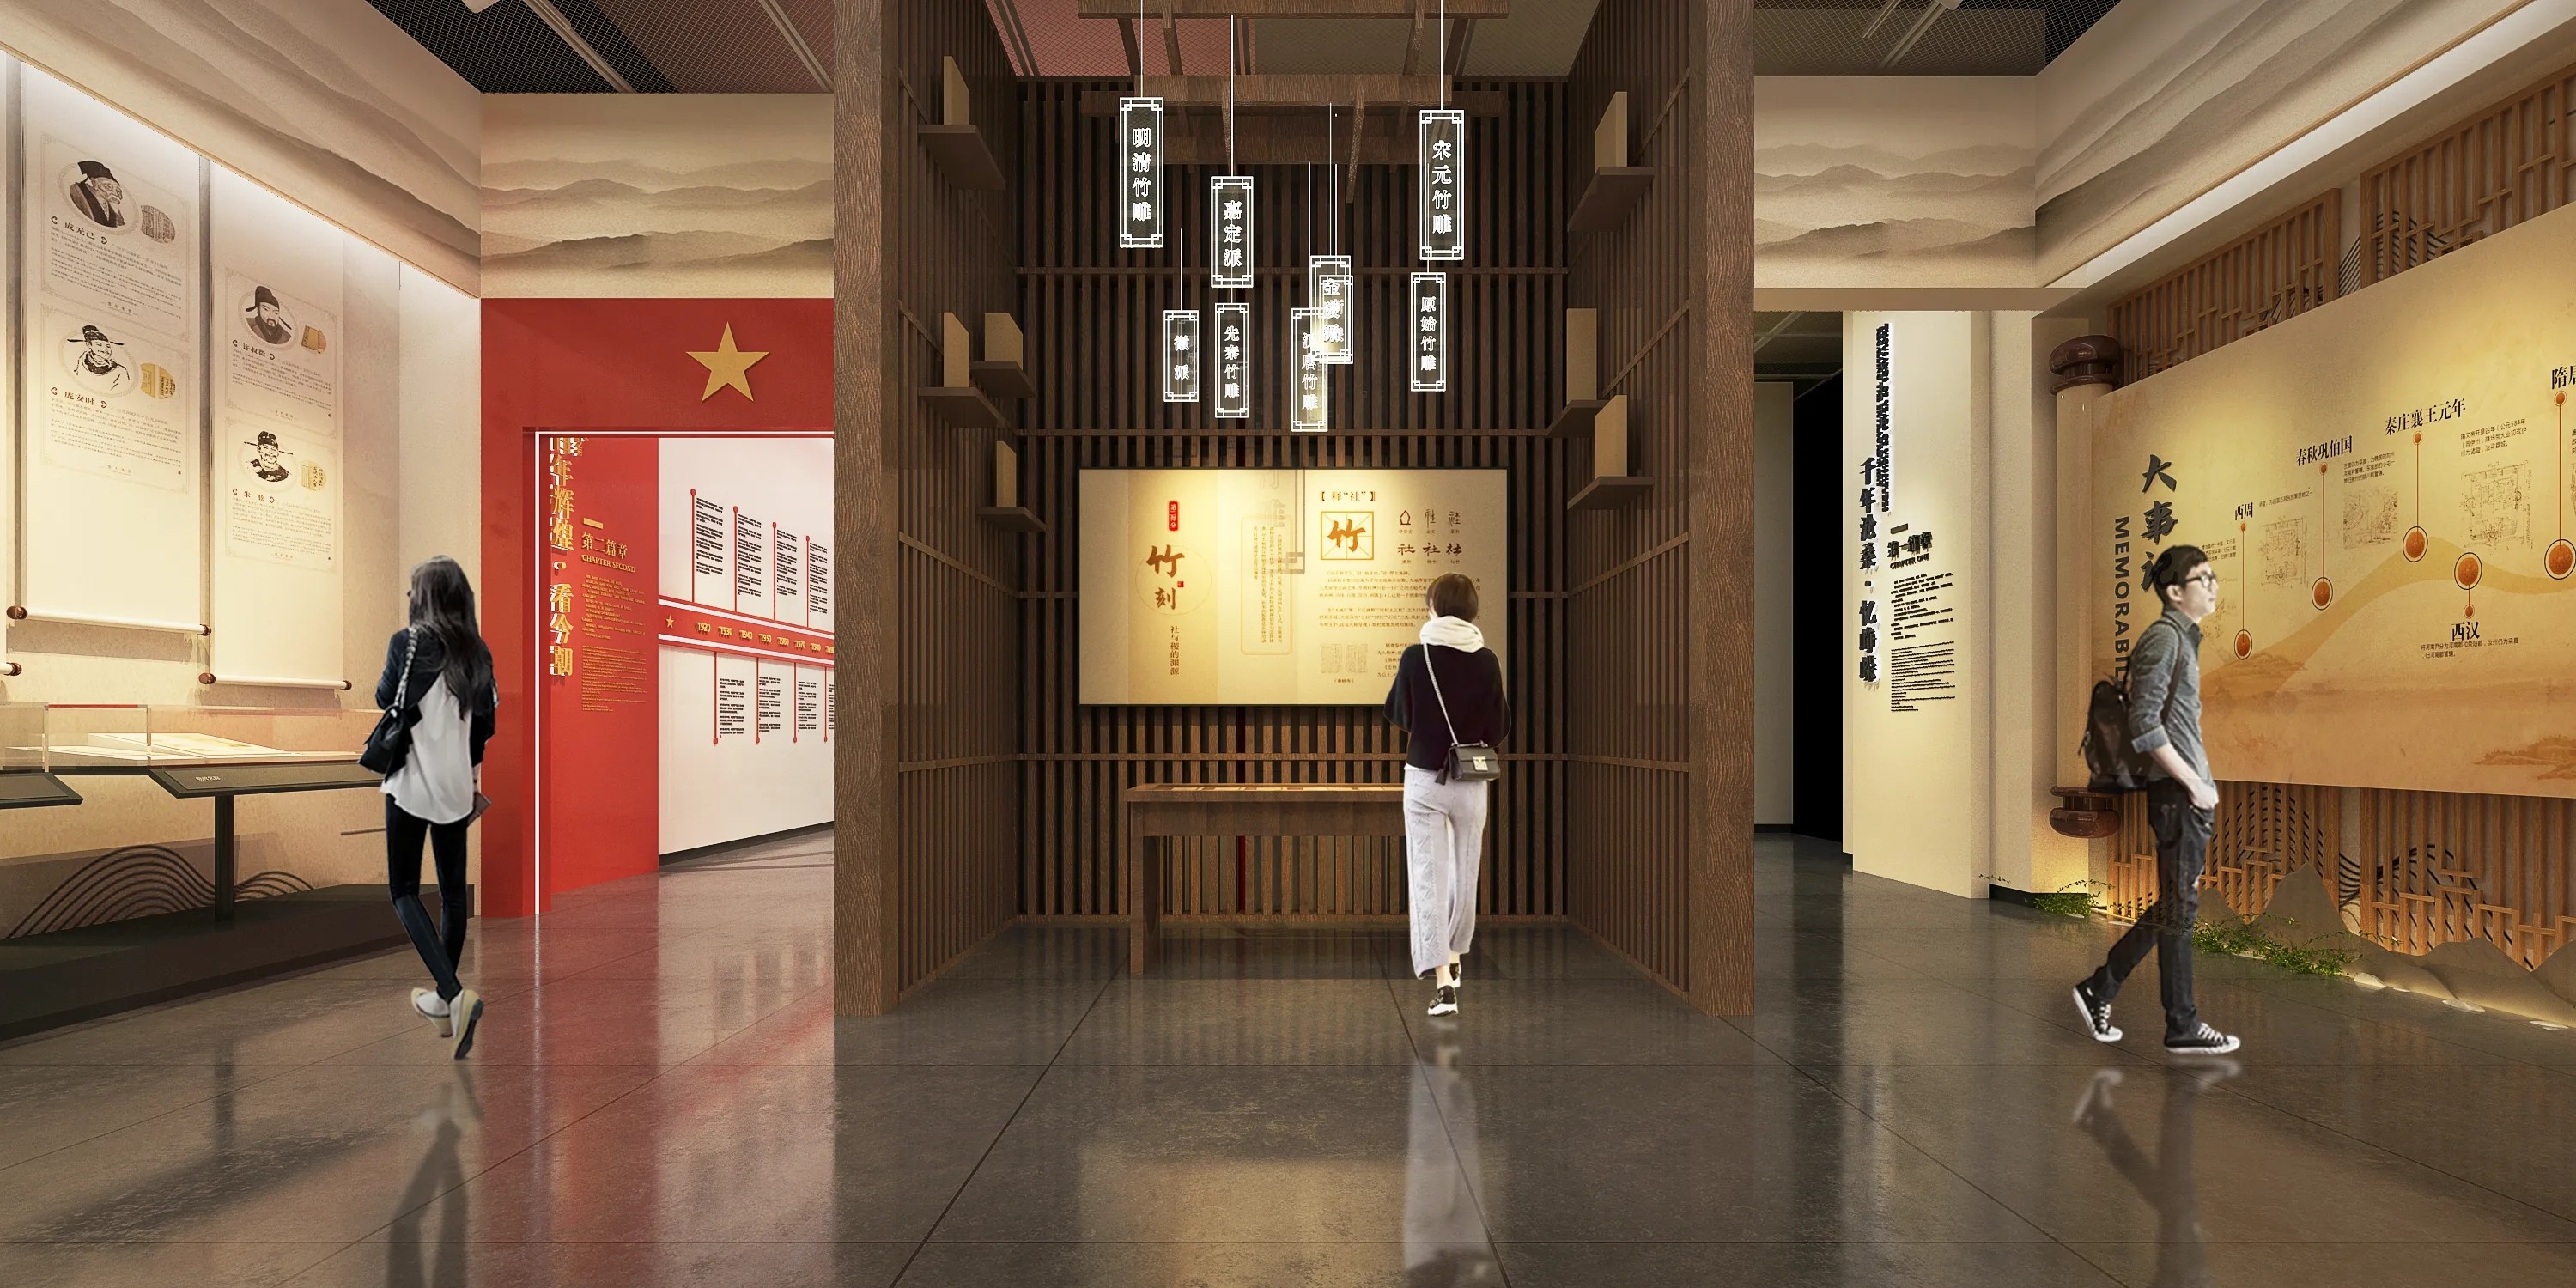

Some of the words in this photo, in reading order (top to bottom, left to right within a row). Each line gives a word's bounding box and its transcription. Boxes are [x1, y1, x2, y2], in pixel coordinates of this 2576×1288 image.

[1132, 127, 1152, 222] 明清竹雕
[1432, 140, 1452, 234] 宋元竹雕
[1223, 200, 1242, 268] 嘉定派
[1420, 296, 1437, 372] 原始竹雕
[1224, 325, 1241, 398] 先秦竹雕
[2385, 397, 2466, 436] 秦庄襄王元年
[2295, 435, 2353, 466] 春秋巩伯国
[2234, 501, 2253, 521] 西周
[581, 532, 628, 559] 第二篇章
[1327, 519, 1367, 552] 竹
[1397, 544, 1415, 556] 社
[1422, 542, 1441, 556] 社
[1446, 543, 1462, 556] 社
[581, 554, 611, 567] CHAPTER
[611, 560, 636, 574] SECOND
[1145, 544, 1185, 611] 竹刻
[2114, 516, 2129, 677] MEMORABIL
[696, 622, 711, 633] 1920
[718, 626, 733, 636] 1930
[739, 629, 753, 640] 1940
[759, 633, 772, 643] 1950
[2451, 620, 2481, 642] 西汉
